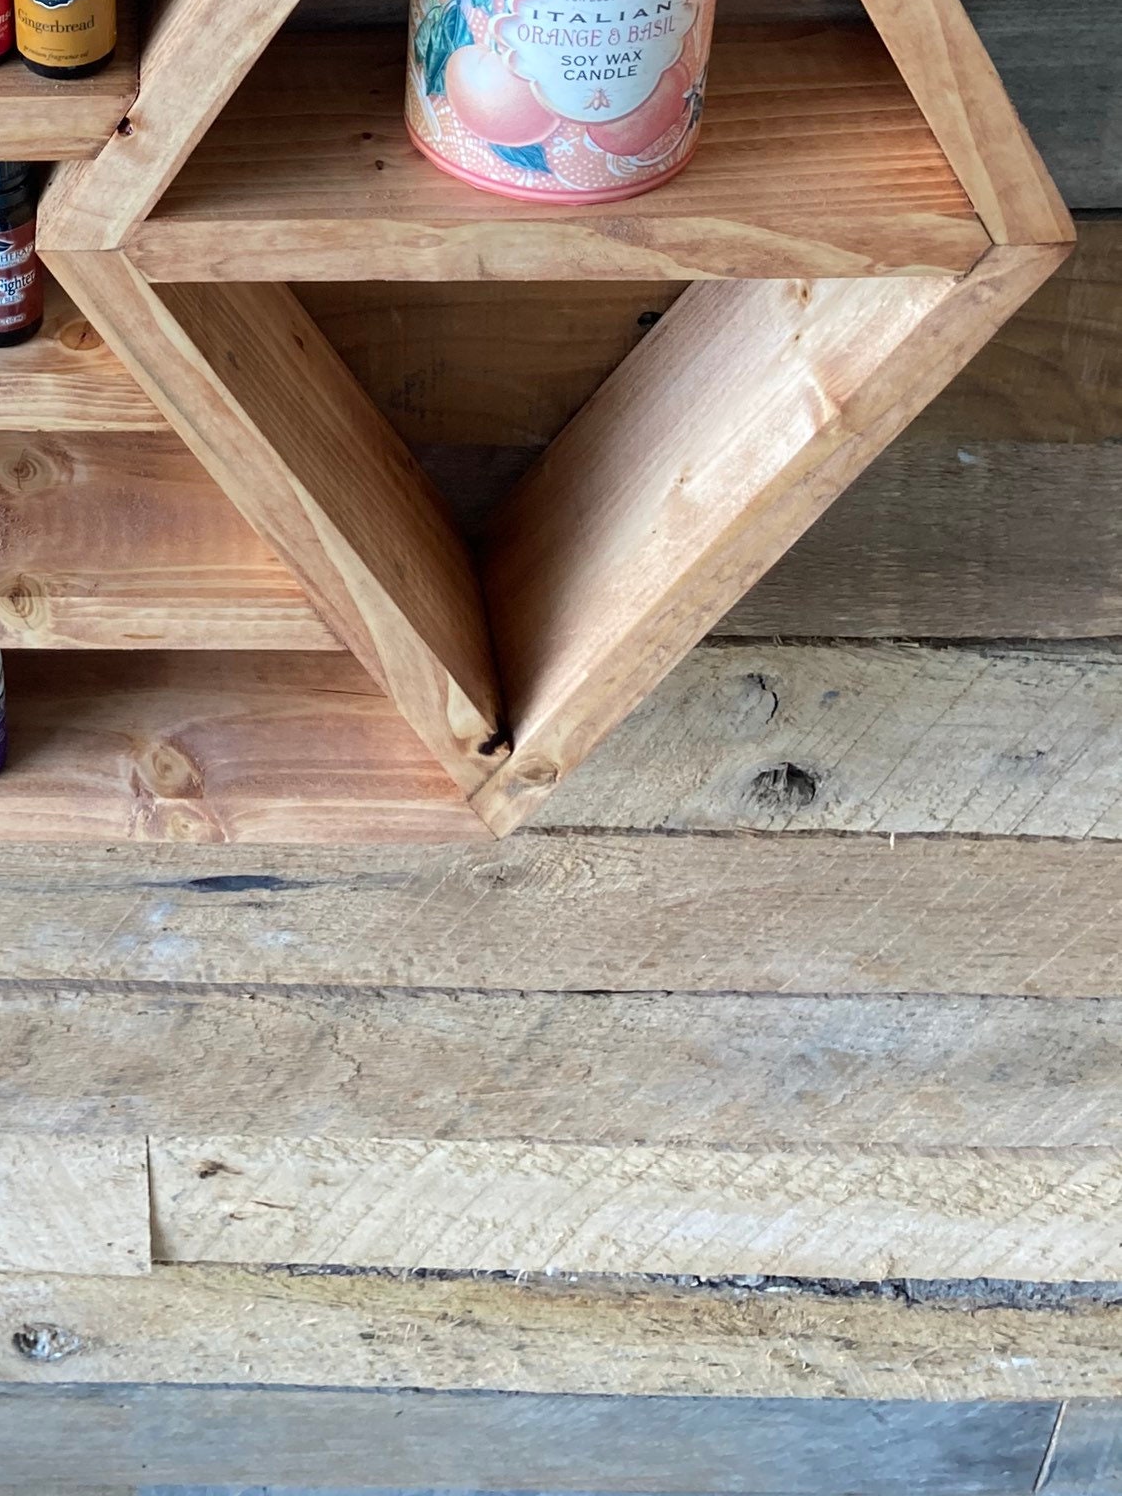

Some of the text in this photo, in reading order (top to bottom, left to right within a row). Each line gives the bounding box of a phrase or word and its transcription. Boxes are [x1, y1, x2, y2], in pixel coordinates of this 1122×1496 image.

[18, 8, 95, 34] Gingerbread
[532, 0, 672, 24] ITALIAN
[517, 15, 677, 48] ORANGE & BASIL
[561, 49, 643, 67] SOY WAX
[563, 64, 638, 81] CANDLE
